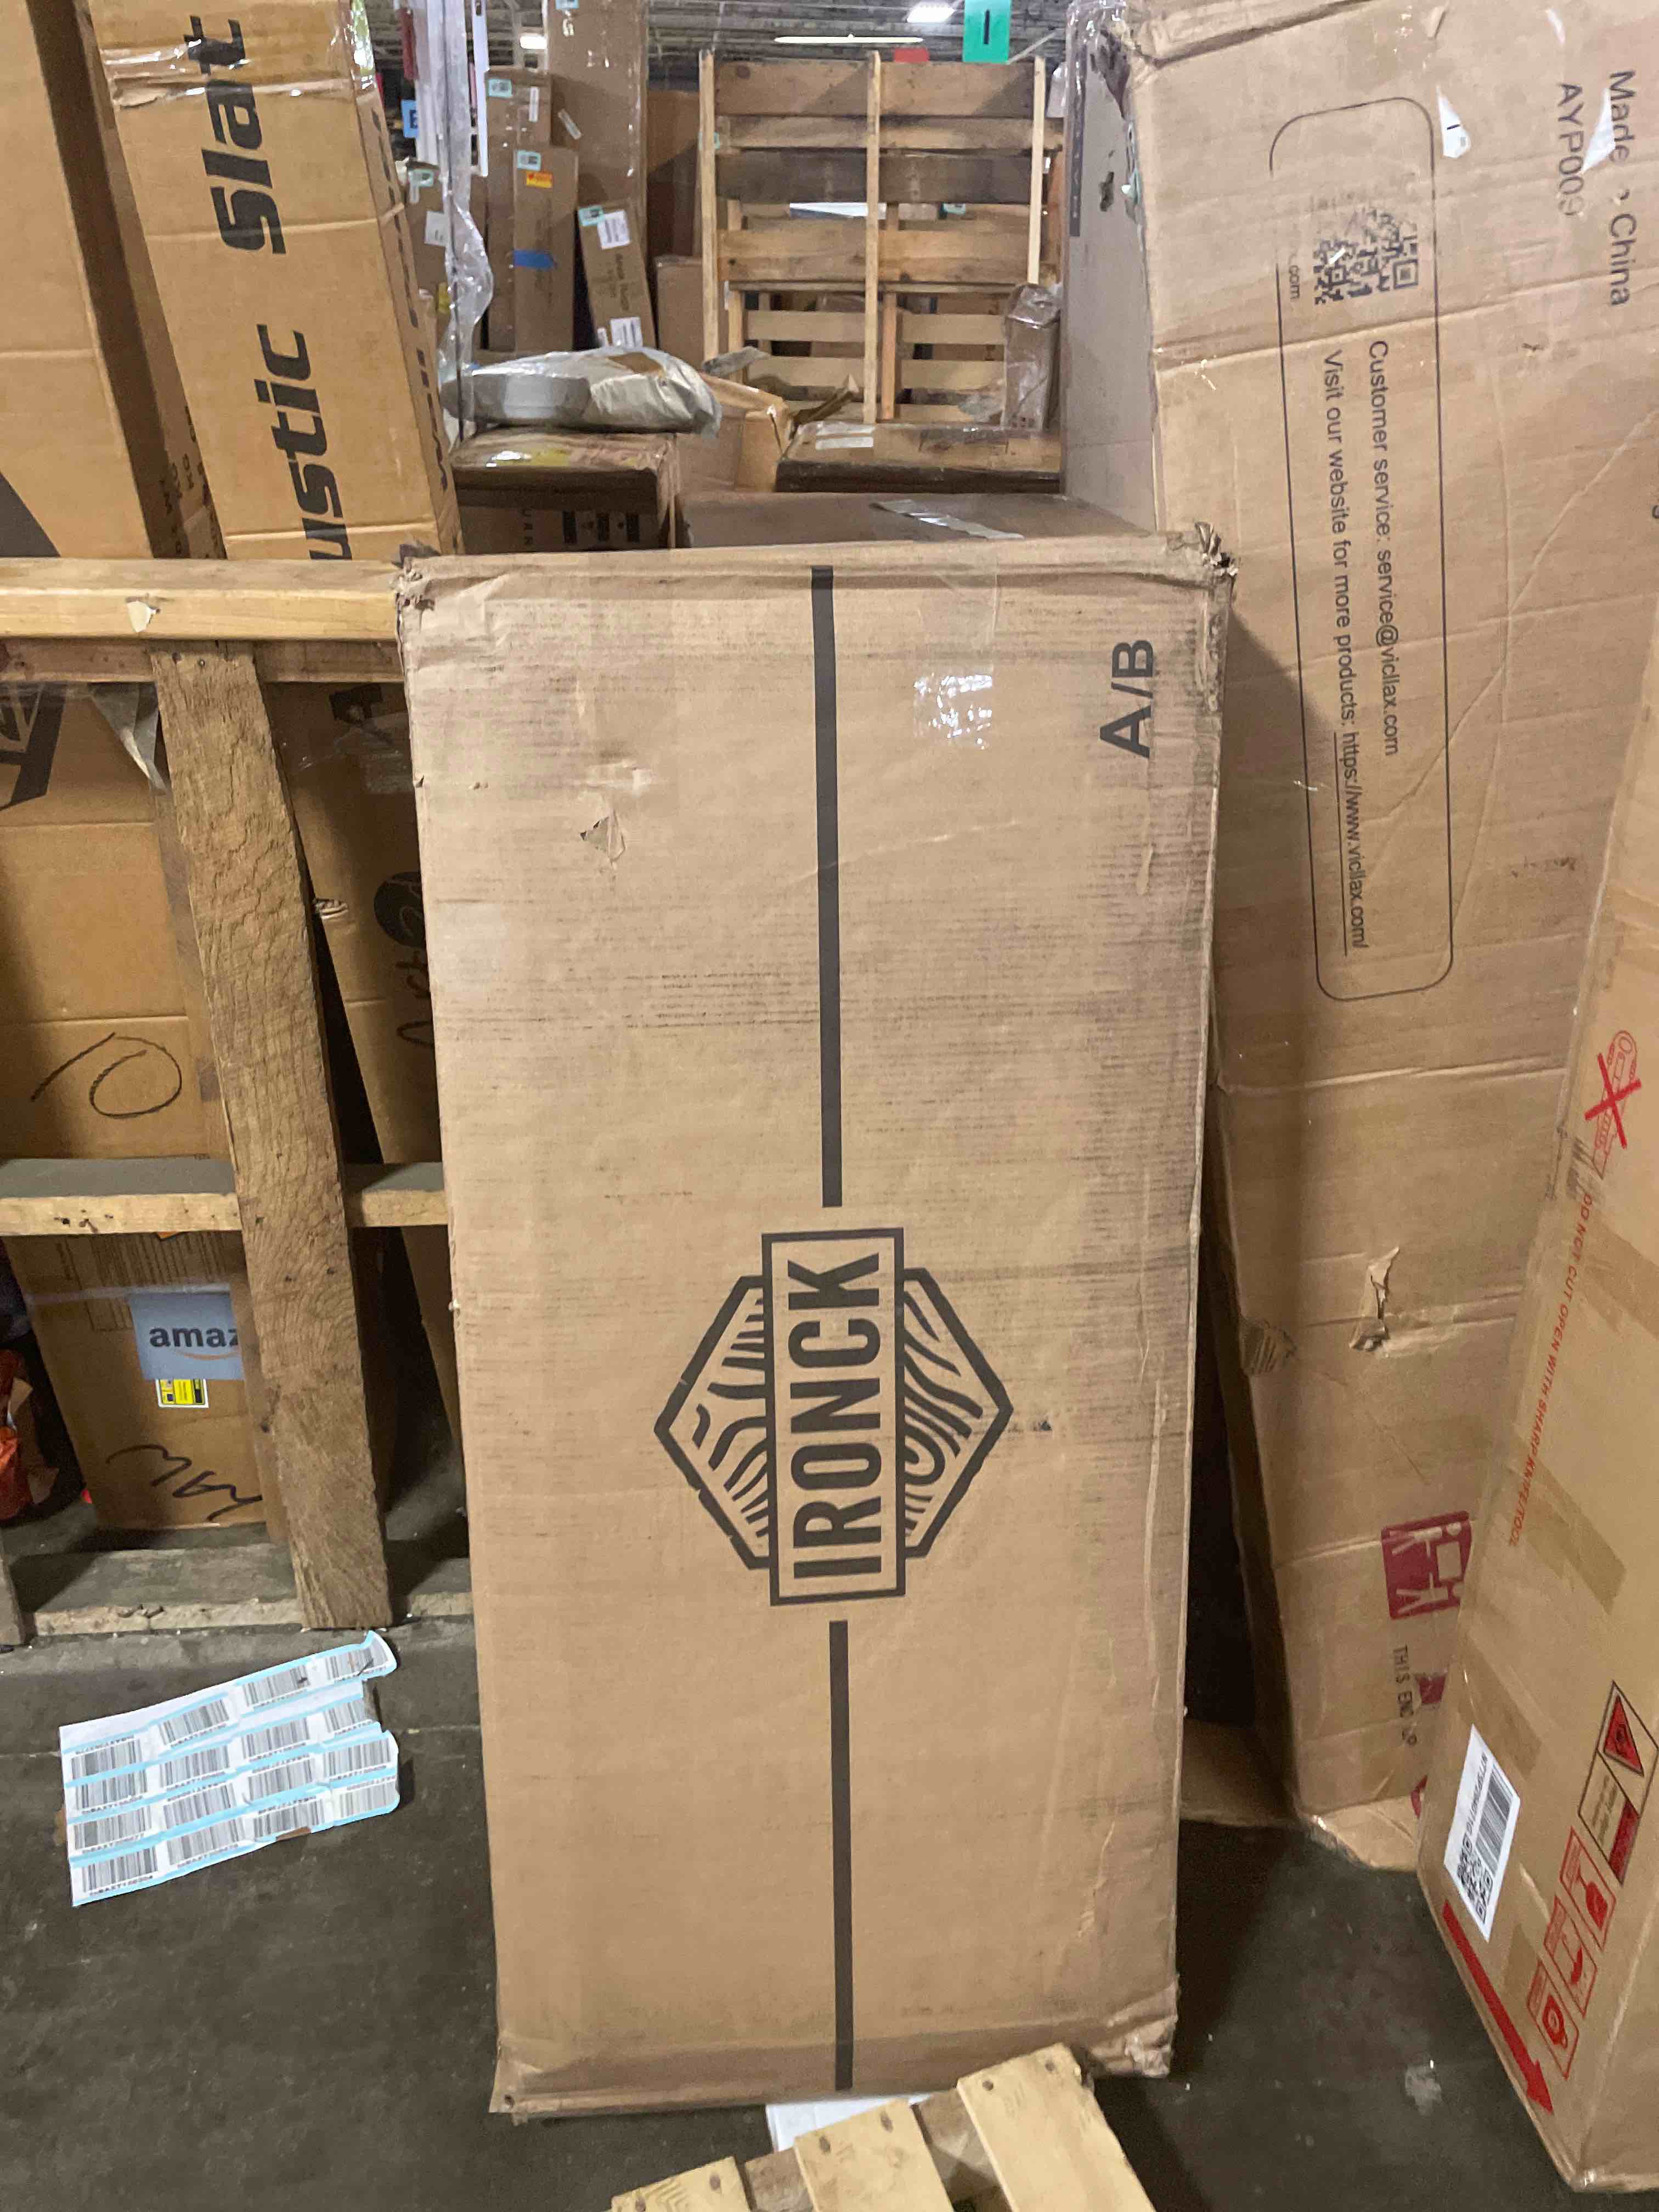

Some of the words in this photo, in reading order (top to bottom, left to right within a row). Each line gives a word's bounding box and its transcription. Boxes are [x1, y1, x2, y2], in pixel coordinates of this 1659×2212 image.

[184, 15, 286, 254] Slat
[1609, 70, 1636, 163] Made
[1610, 213, 1637, 306] China
[1324, 349, 1344, 401] Visit
[1369, 341, 1388, 452] Customer
[1327, 408, 1342, 443] our
[1329, 449, 1350, 534] website
[1373, 459, 1393, 542] service:
[1333, 539, 1352, 568] for
[1334, 575, 1351, 628] more
[1099, 640, 1154, 758] A/B
[1334, 634, 1358, 727] products:
[1571, 1222, 1587, 1261] NOT
[1564, 1264, 1577, 1302] CUT
[1550, 1302, 1568, 1352] OPEN
[1541, 1354, 1557, 1397] WITH
[787, 1253, 882, 1579] IRONCK
[1530, 1398, 1548, 1458] SHARP
[1393, 1645, 1410, 1684] THIS
